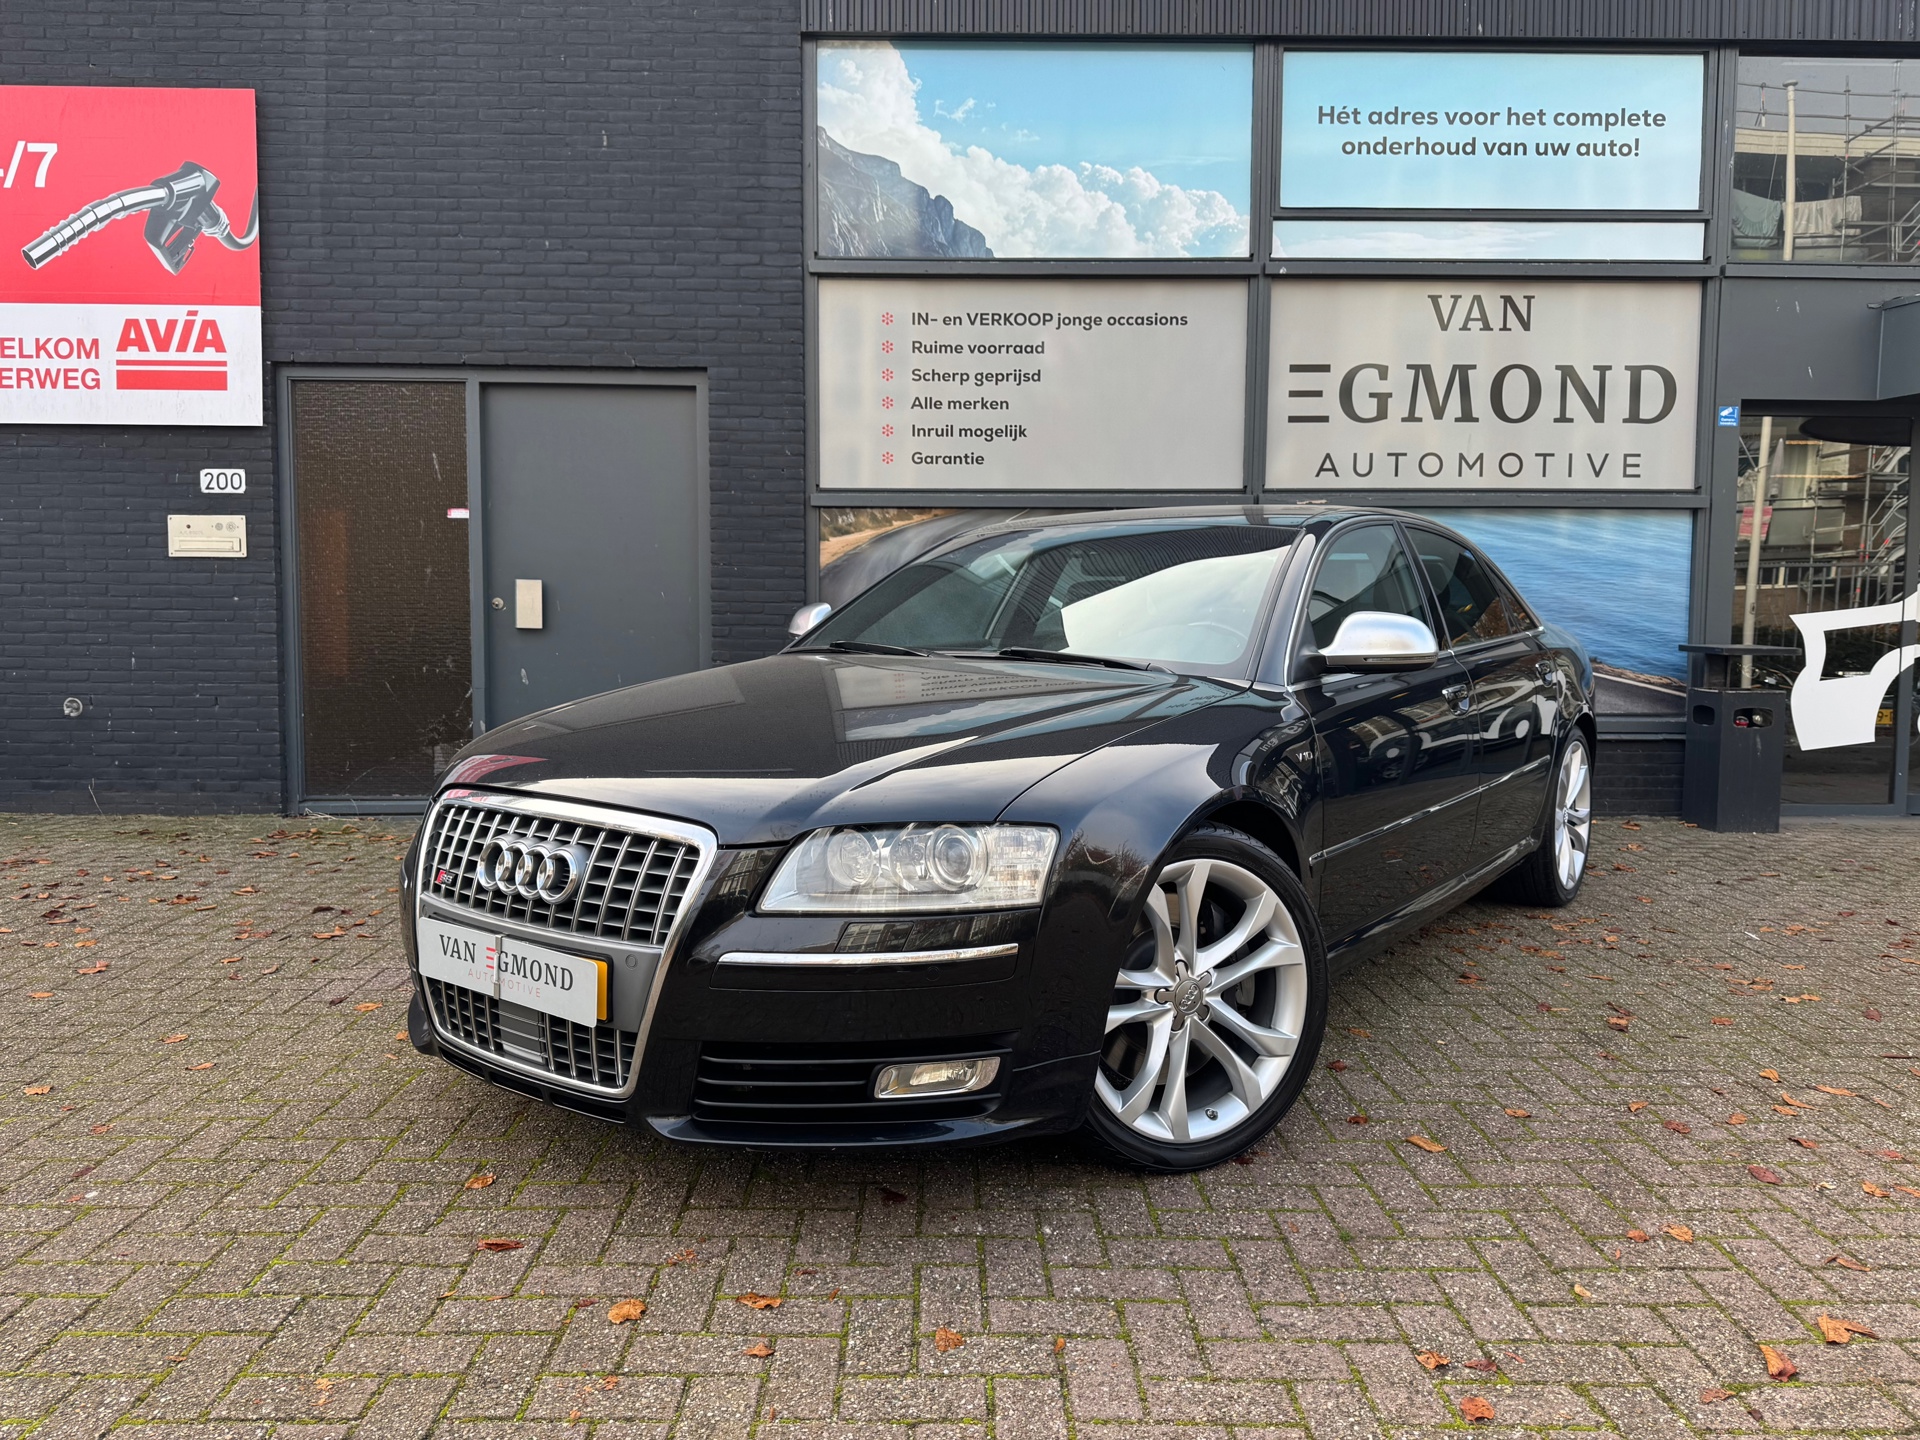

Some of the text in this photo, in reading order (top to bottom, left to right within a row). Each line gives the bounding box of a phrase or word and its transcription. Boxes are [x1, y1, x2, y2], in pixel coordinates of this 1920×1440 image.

[1317, 104, 1667, 132] Hét adres voor het complete
[1341, 136, 1641, 158] onderhoud van uw auto!
[0, 140, 58, 188] /7
[911, 312, 1188, 331] IN- en VERKOOP jonge occasions
[1427, 294, 1536, 332] VAN
[911, 340, 1045, 355] Ruime voorraad
[911, 368, 1041, 387] Scherp geprijsd
[911, 396, 1010, 410] Alle merken
[1287, 363, 1678, 425] EGMOND
[911, 424, 1028, 443] Inruil mogelijk
[911, 451, 985, 465] Garantie
[1314, 452, 1642, 479] AUTOMOTIVE
[204, 472, 242, 490] 200
[439, 934, 476, 964] VAN
